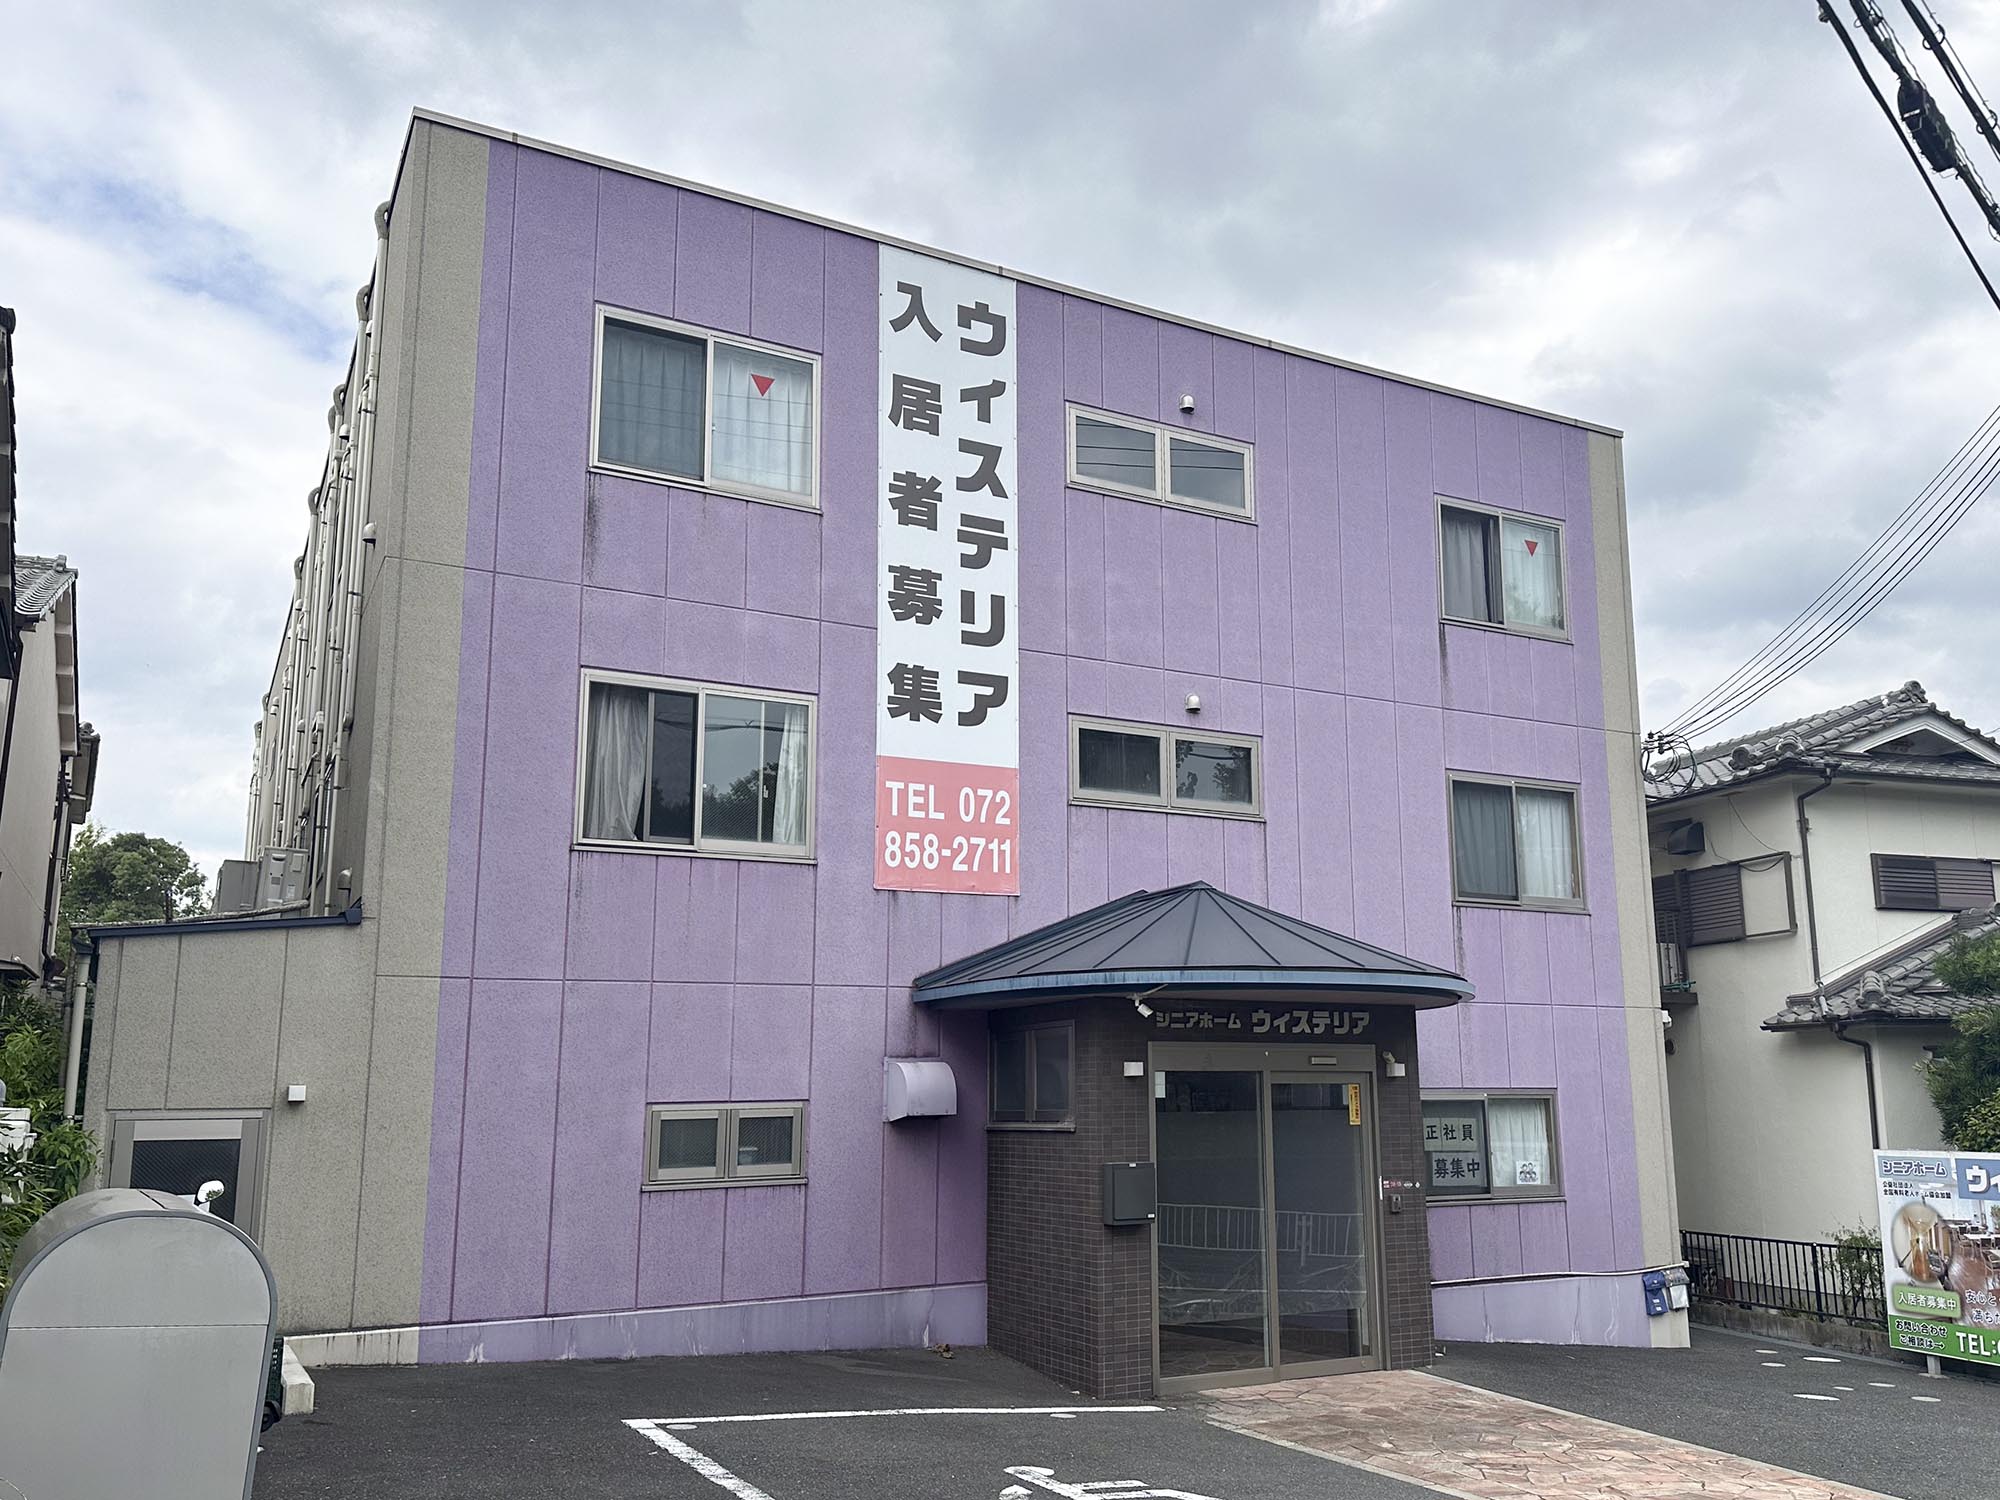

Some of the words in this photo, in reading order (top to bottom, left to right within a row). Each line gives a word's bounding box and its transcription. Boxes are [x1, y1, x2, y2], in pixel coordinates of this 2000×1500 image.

[887, 280, 943, 724] 入居者募集
[956, 301, 1009, 727] ウィステリア
[885, 780, 945, 820] TEL
[958, 786, 1011, 825] 072
[884, 830, 1011, 874] 858-2711
[1155, 1011, 1242, 1029] シニアホーム
[1251, 1009, 1370, 1035] ウィステリア
[1425, 1123, 1474, 1141] 正社員
[1434, 1158, 1480, 1179] 募集中
[1882, 1160, 1947, 1176] シニアホーム
[1898, 1292, 1957, 1311] 入居者募集中
[1895, 1319, 1948, 1337] お問い合わせ
